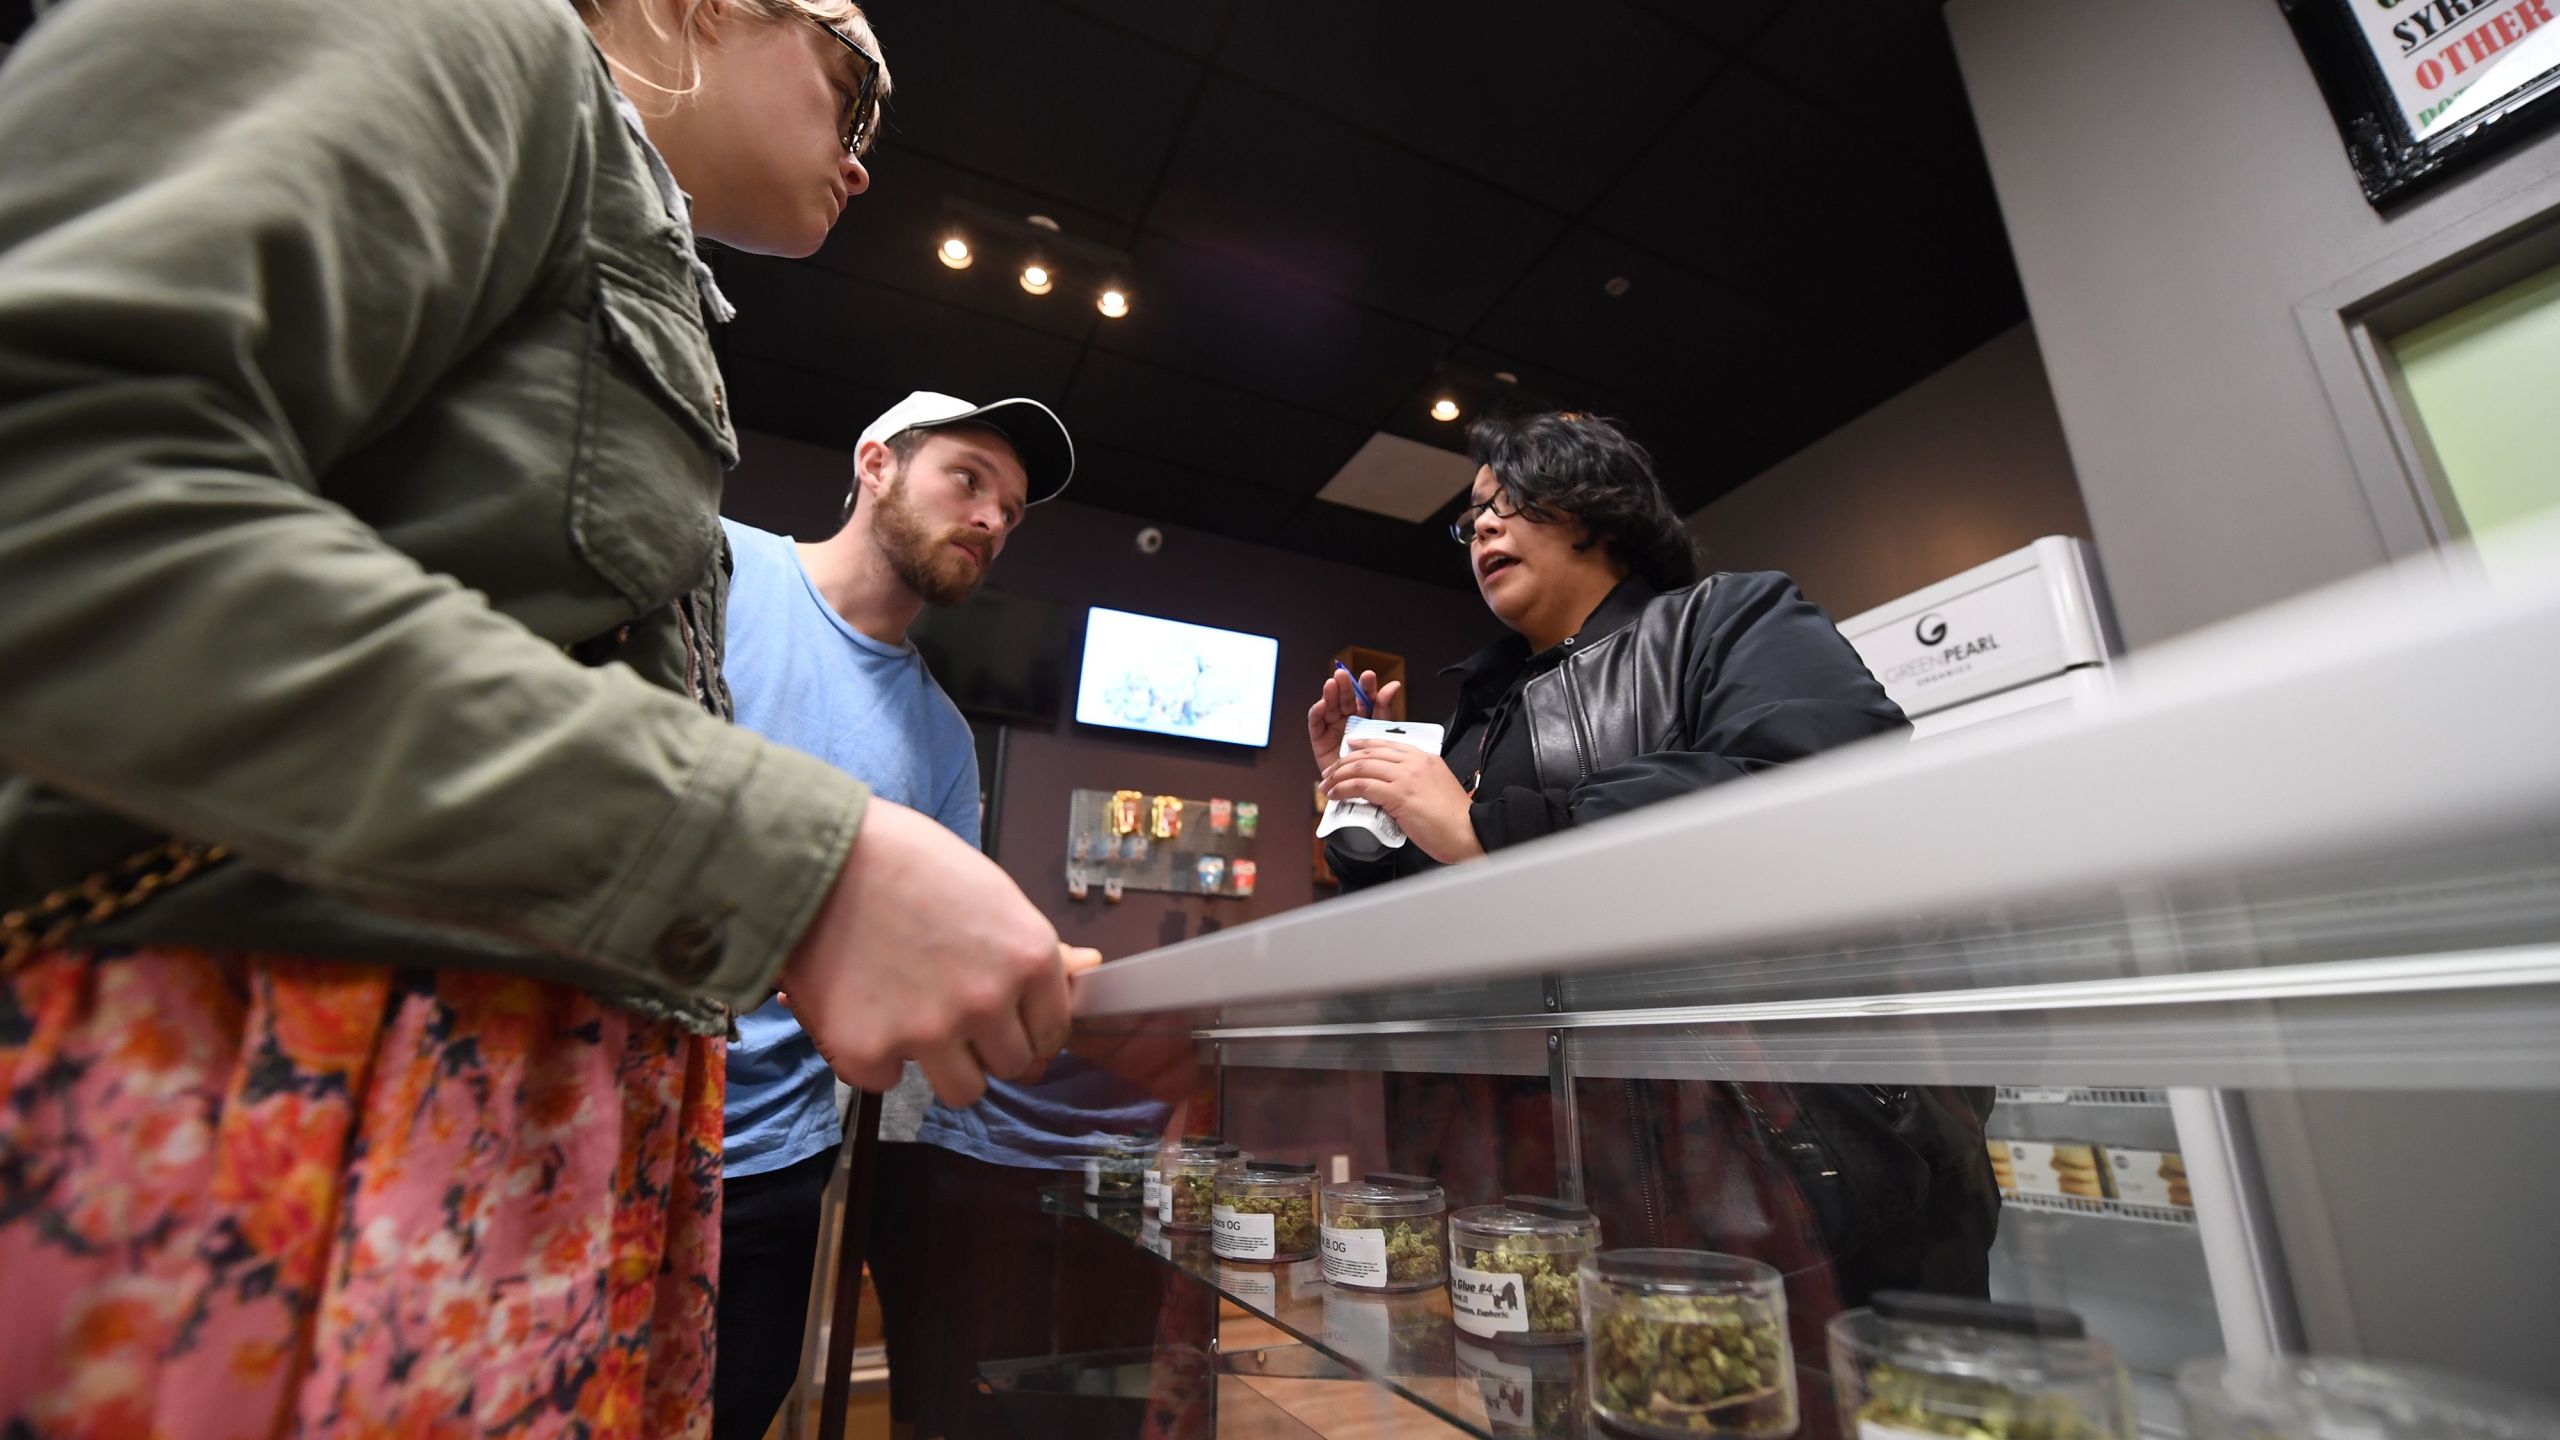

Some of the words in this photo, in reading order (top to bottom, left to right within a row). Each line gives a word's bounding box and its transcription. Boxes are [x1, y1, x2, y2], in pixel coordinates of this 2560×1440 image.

[2393, 0, 2489, 51] SYR
[2416, 0, 2555, 90] OTHER
[1226, 1220, 1241, 1231] OG
[1457, 1279, 1476, 1293] Glue
